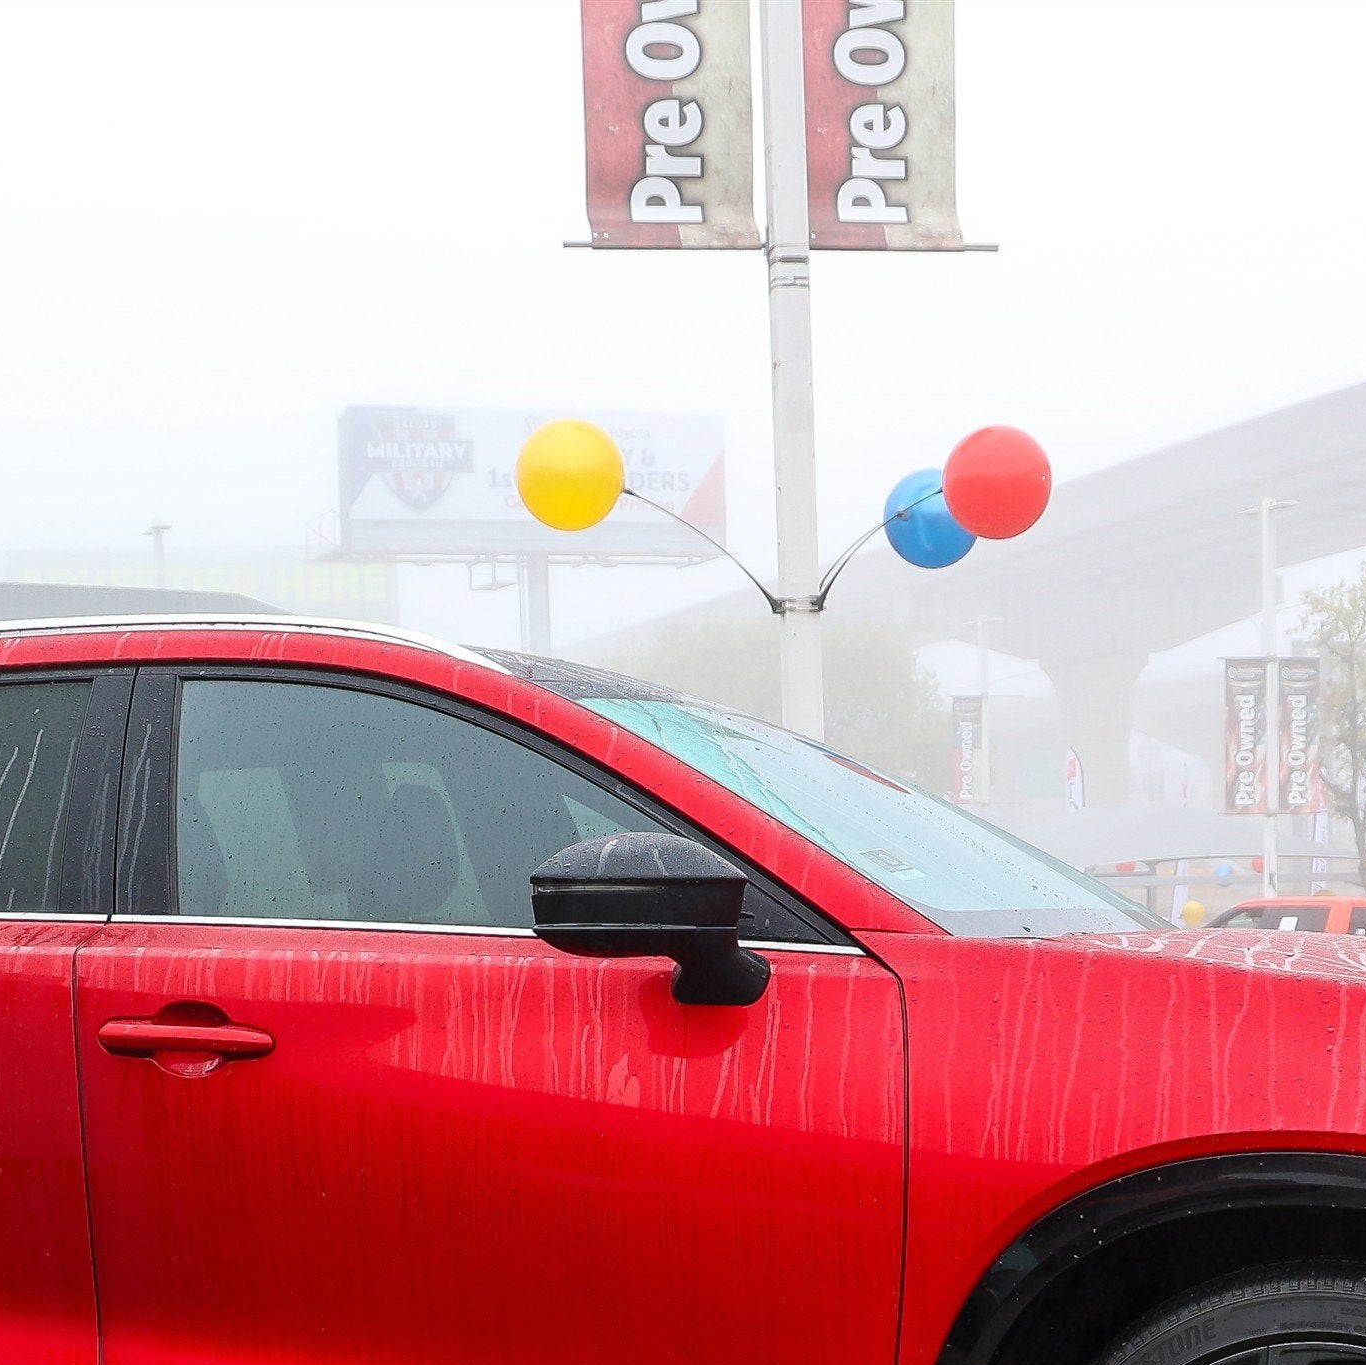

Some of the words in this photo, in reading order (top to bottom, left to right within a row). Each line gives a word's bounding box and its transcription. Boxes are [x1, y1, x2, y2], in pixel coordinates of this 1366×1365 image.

[630, 99, 705, 224] Pre
[837, 103, 910, 223] Pre
[366, 441, 468, 459] MILITARY
[1235, 694, 1256, 767] Owned
[1287, 693, 1308, 766] Owned
[1235, 770, 1256, 806] Pre
[1288, 769, 1308, 805] Pre
